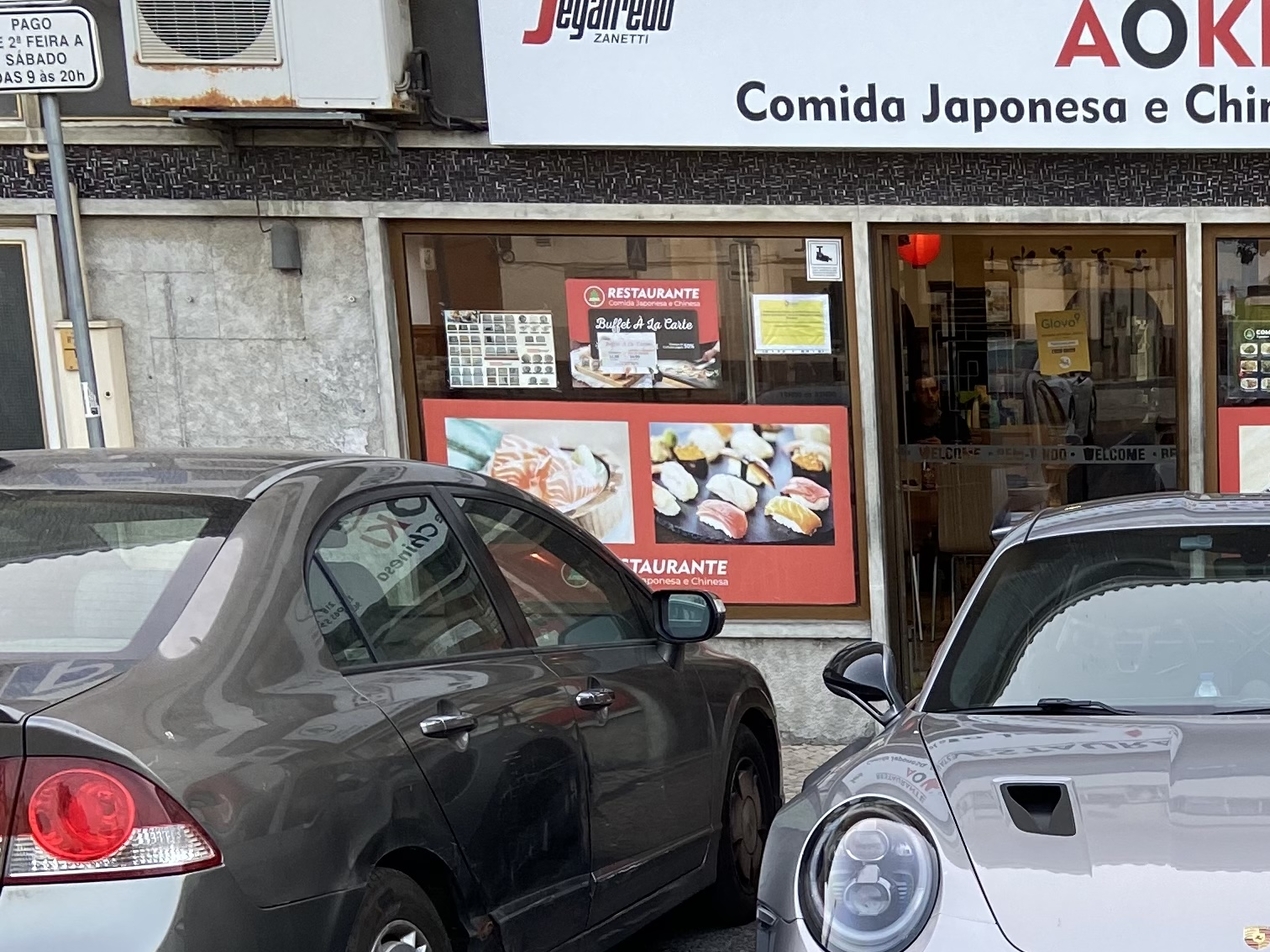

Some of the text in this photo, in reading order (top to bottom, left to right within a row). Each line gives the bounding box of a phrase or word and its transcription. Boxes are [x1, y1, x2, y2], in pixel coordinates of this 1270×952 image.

[11, 17, 52, 31] PAGO
[26, 34, 69, 48] FEIRA
[74, 34, 84, 47] A
[593, 33, 649, 44] ZANETTI
[5, 49, 68, 67] SÁBADO
[0, 69, 86, 84] AS 9 às 20h
[736, 80, 906, 123] Comida
[922, 83, 1127, 133] Japonesa
[1145, 97, 1168, 123] e
[607, 287, 700, 299] RESTAURANTE
[595, 317, 631, 333] Buffet
[664, 317, 694, 330] Carte
[1041, 319, 1076, 329] Glovo
[1082, 447, 1146, 461] WELCOME
[621, 558, 728, 575] TAURANTE
[641, 576, 729, 586] aponesa e Chinesa
